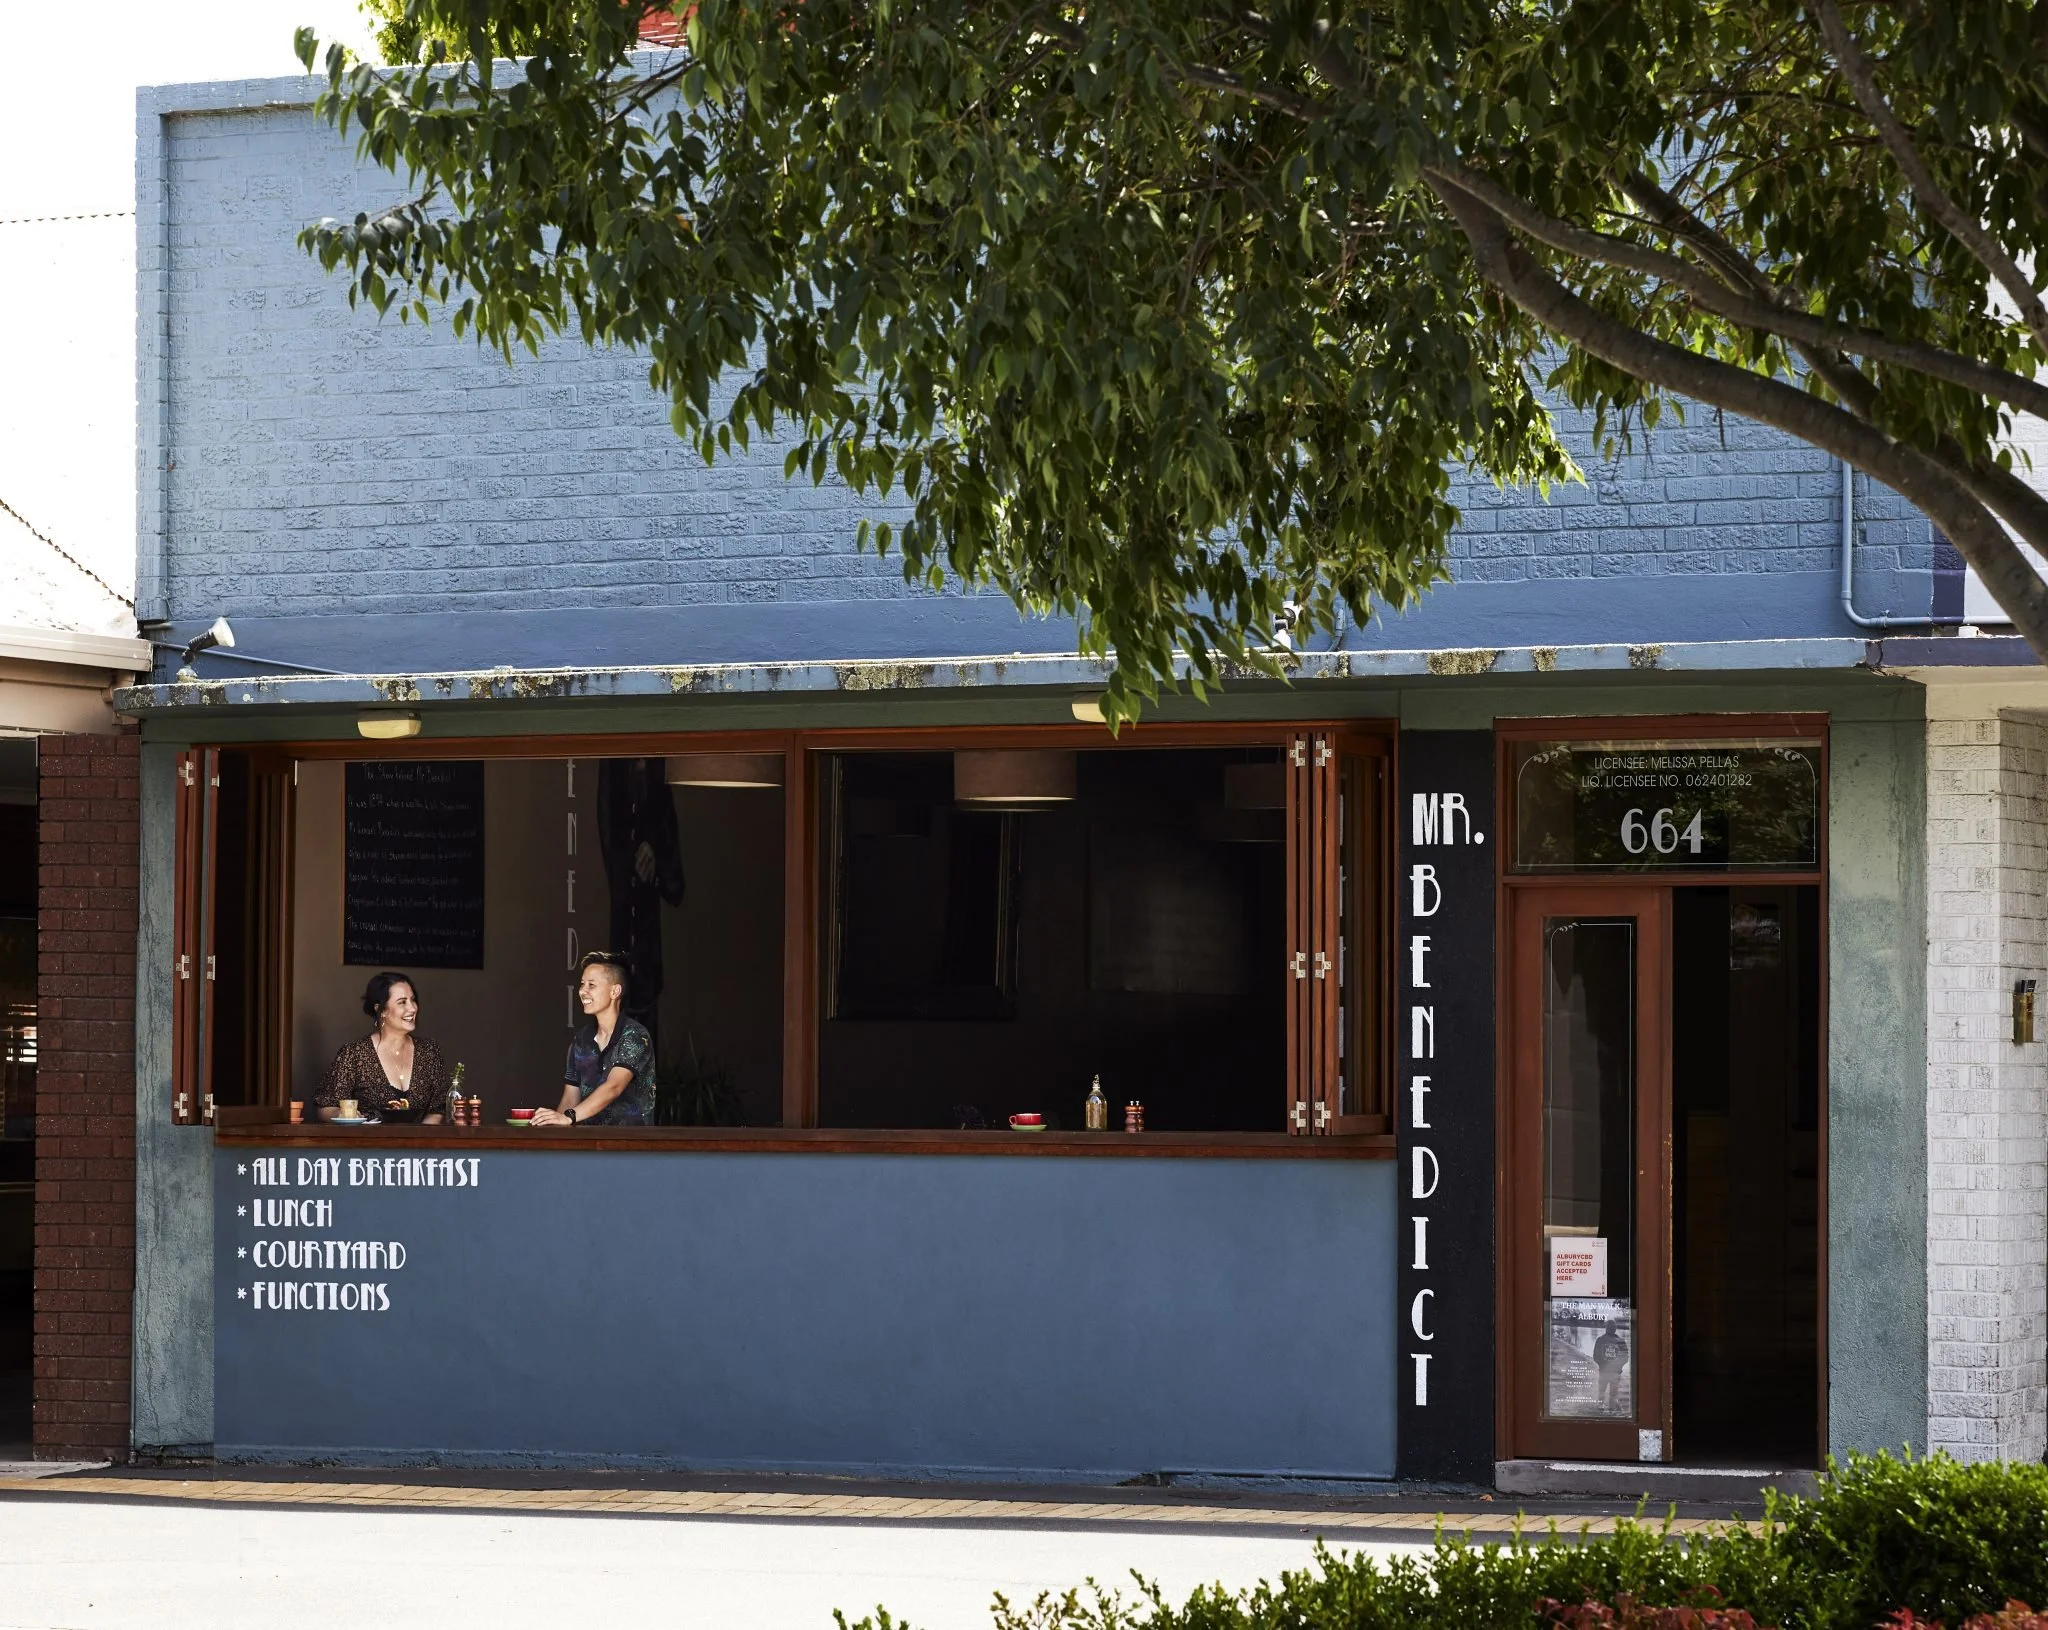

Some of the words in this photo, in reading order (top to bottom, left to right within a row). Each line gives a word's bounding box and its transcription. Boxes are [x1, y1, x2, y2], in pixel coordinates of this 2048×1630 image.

[1594, 758, 1648, 769] LICENSEE:
[1651, 757, 1697, 769] MELISSA
[1699, 755, 1740, 768] PELLAS
[1582, 776, 1604, 788] LIQ.
[1606, 775, 1657, 787] LICENSEE
[1660, 775, 1682, 787] NO.
[1686, 774, 1752, 787] 062401282
[1412, 793, 1485, 845] MR.
[1620, 808, 1704, 854] 664
[1409, 864, 1442, 1406] BENEDICT
[252, 1158, 290, 1186] ALL
[298, 1158, 342, 1186] DAY
[348, 1158, 480, 1187] BREAKFAST
[253, 1199, 333, 1227] LUNCH
[253, 1241, 406, 1270] COURTYARD
[252, 1282, 391, 1311] FUNCTIONS
[1579, 1302, 1597, 1310] MAN
